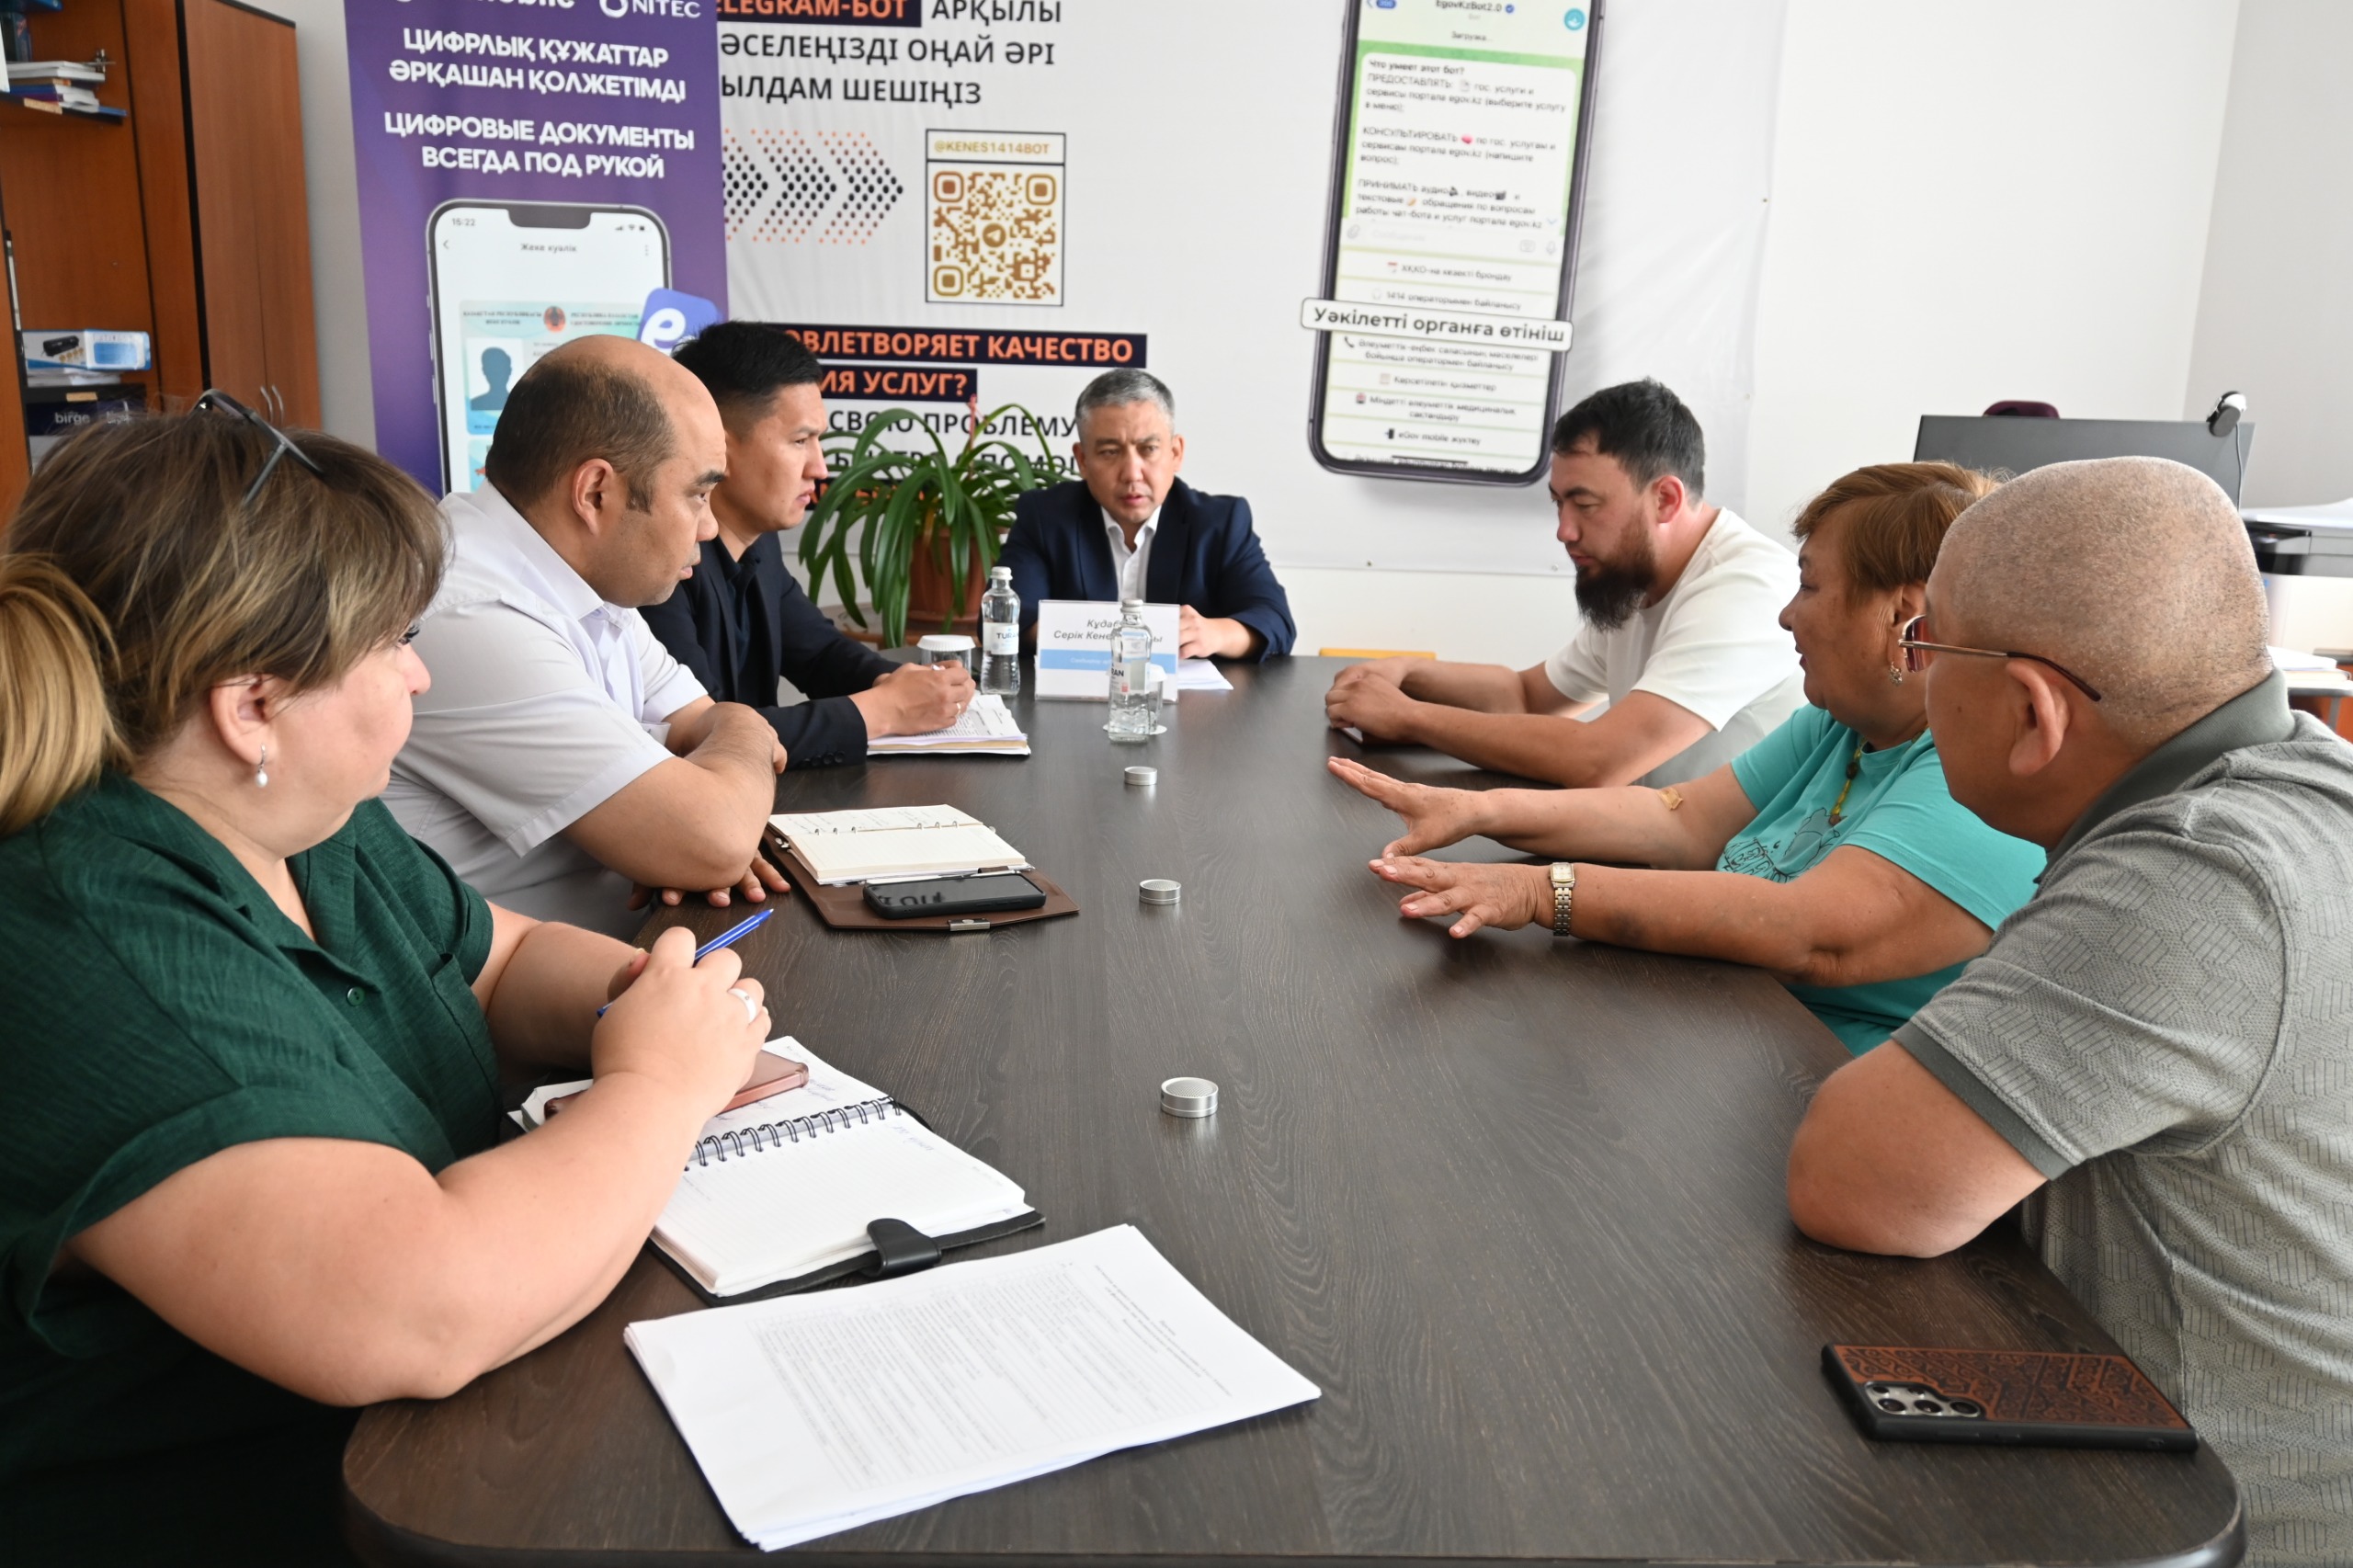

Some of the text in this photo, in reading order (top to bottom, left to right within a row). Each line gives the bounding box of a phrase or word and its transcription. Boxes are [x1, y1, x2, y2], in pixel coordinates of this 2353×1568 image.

[932, 0, 1062, 26] АРҚЫЛЫ
[403, 28, 668, 68] ЦИФРЛЫҚ ҚҰЖАТТАР
[721, 34, 1053, 67] ӘСЕЛЕҢІЗДІ ОҢАЙ ӘРІ
[389, 59, 686, 104] ӘРҚАШАН ҚОЛЖЕТІМДІ
[722, 76, 982, 108] ЫЛДАМ ШЕШІҢІЗ
[385, 111, 694, 151] ЦИФРОВЫЕ ДОКУМЕНТЫ
[934, 140, 1050, 154] @KENES1414BOT
[423, 146, 665, 178] ВСЕГДА ПОД РУКОЙ
[1314, 307, 1564, 343] Уәкілетті органға өтініш
[988, 335, 1132, 362] КАЧЕСТВО
[864, 372, 968, 395] УСЛУГ?
[924, 413, 1076, 437] ПРОБЛЕМУ
[1054, 631, 1084, 641] Серік
